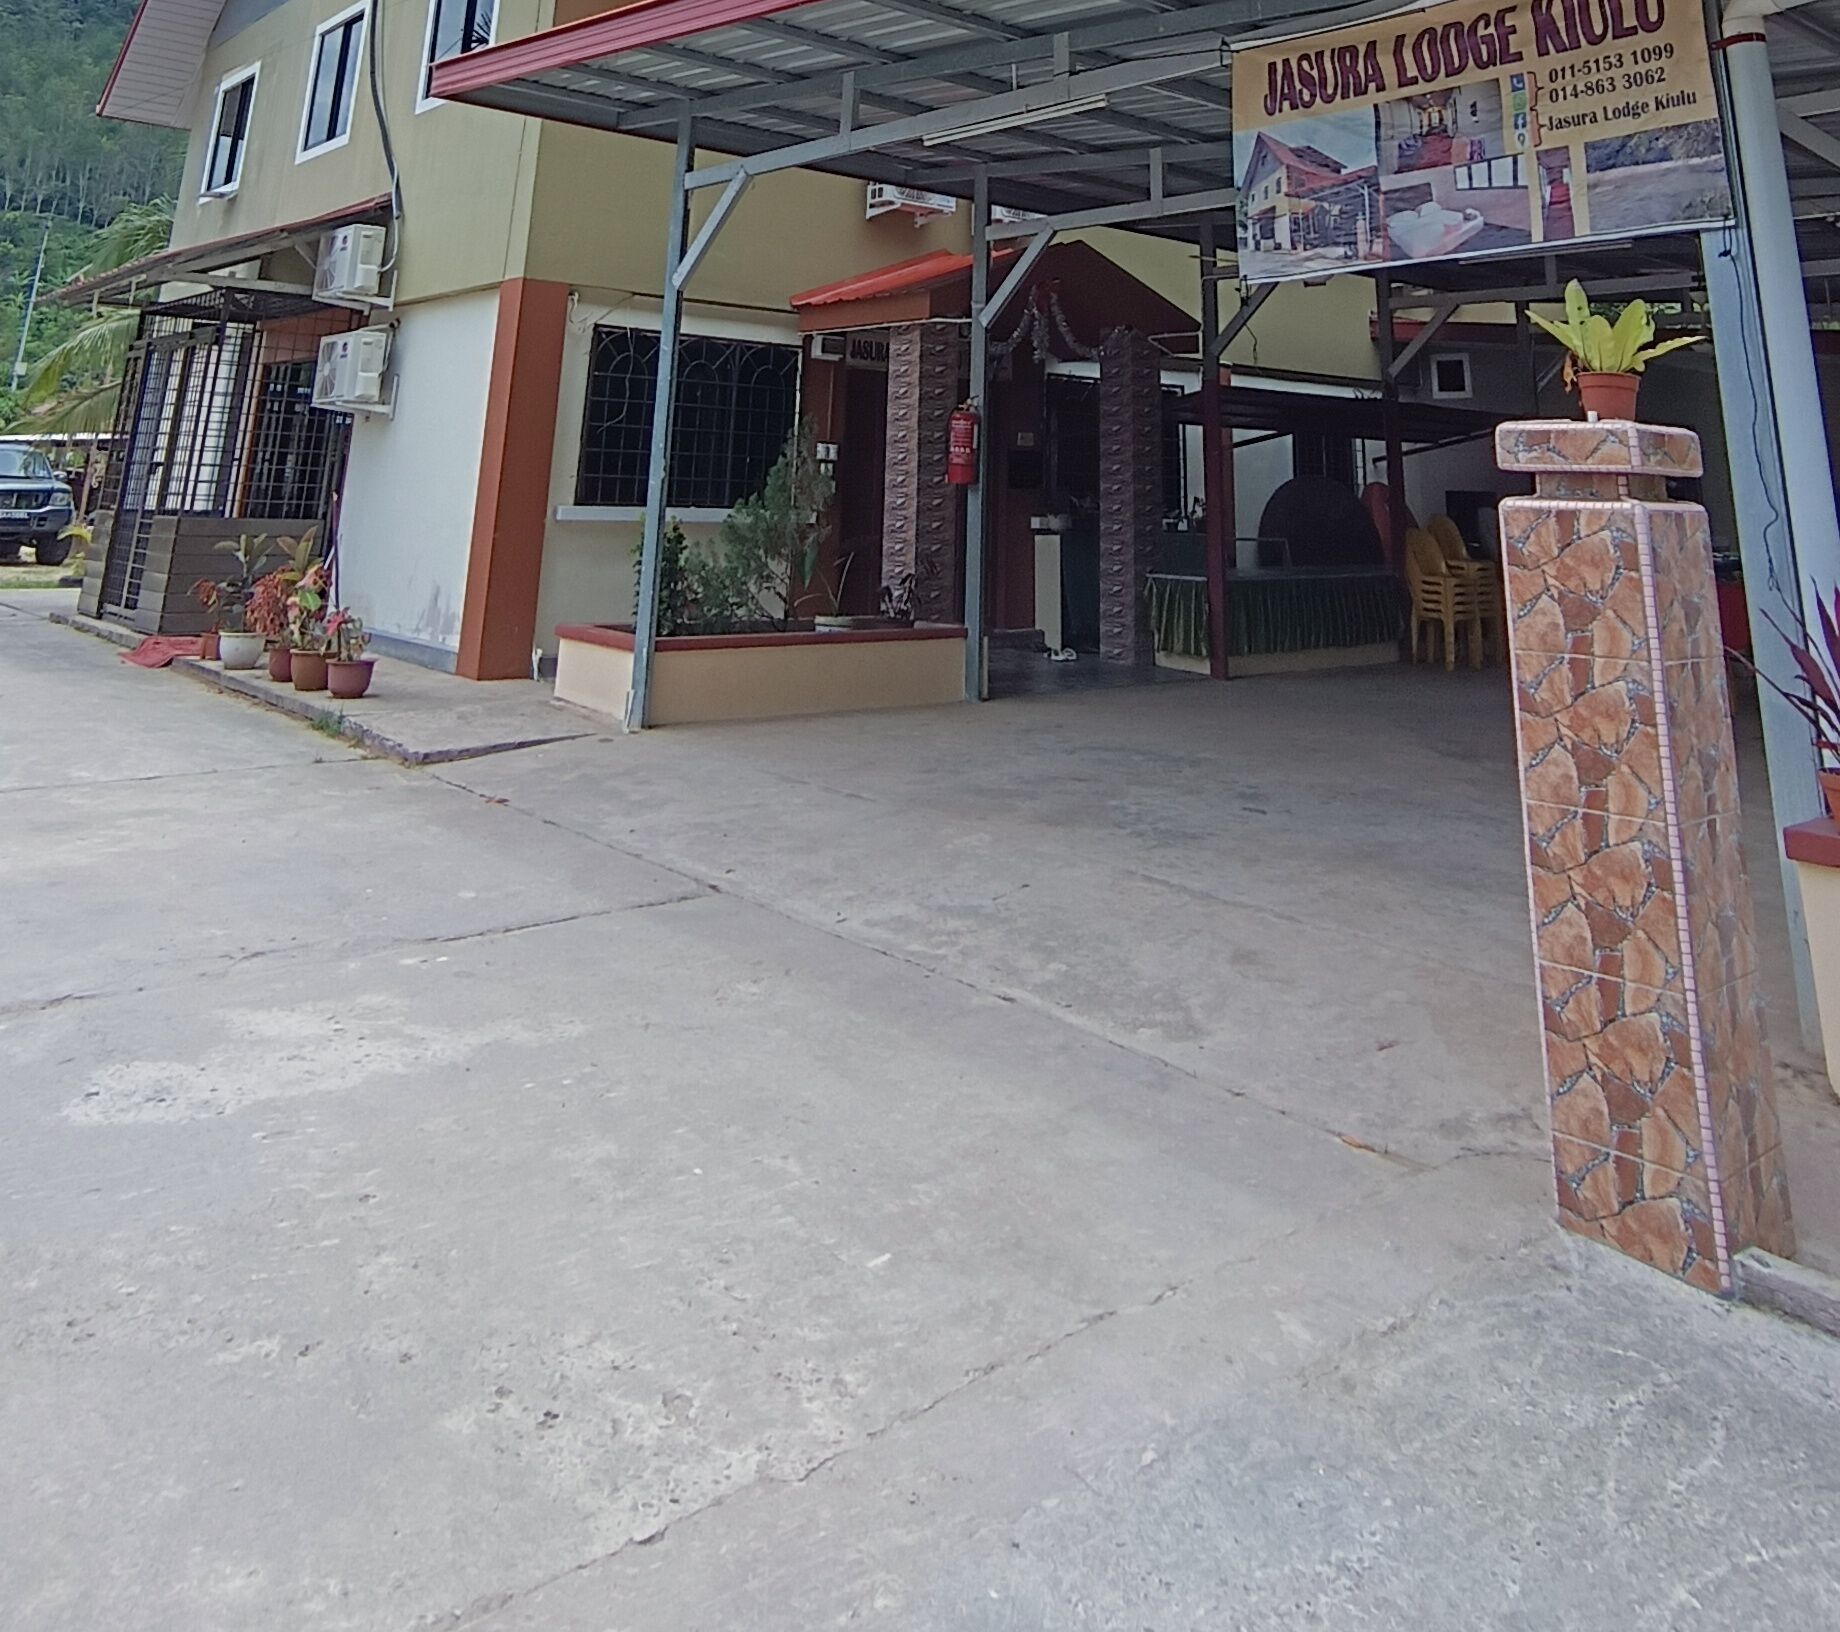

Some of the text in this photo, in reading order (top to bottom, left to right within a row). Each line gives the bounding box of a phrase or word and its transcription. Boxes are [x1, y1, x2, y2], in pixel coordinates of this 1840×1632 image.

[1264, 39, 1386, 116] JASURA
[1393, 5, 1524, 89] LODGE
[1548, 42, 1675, 84] 011-5153 1099
[1549, 66, 1667, 103] 014-863 3062
[1546, 89, 1697, 132] Jasura Lodge Kiulu
